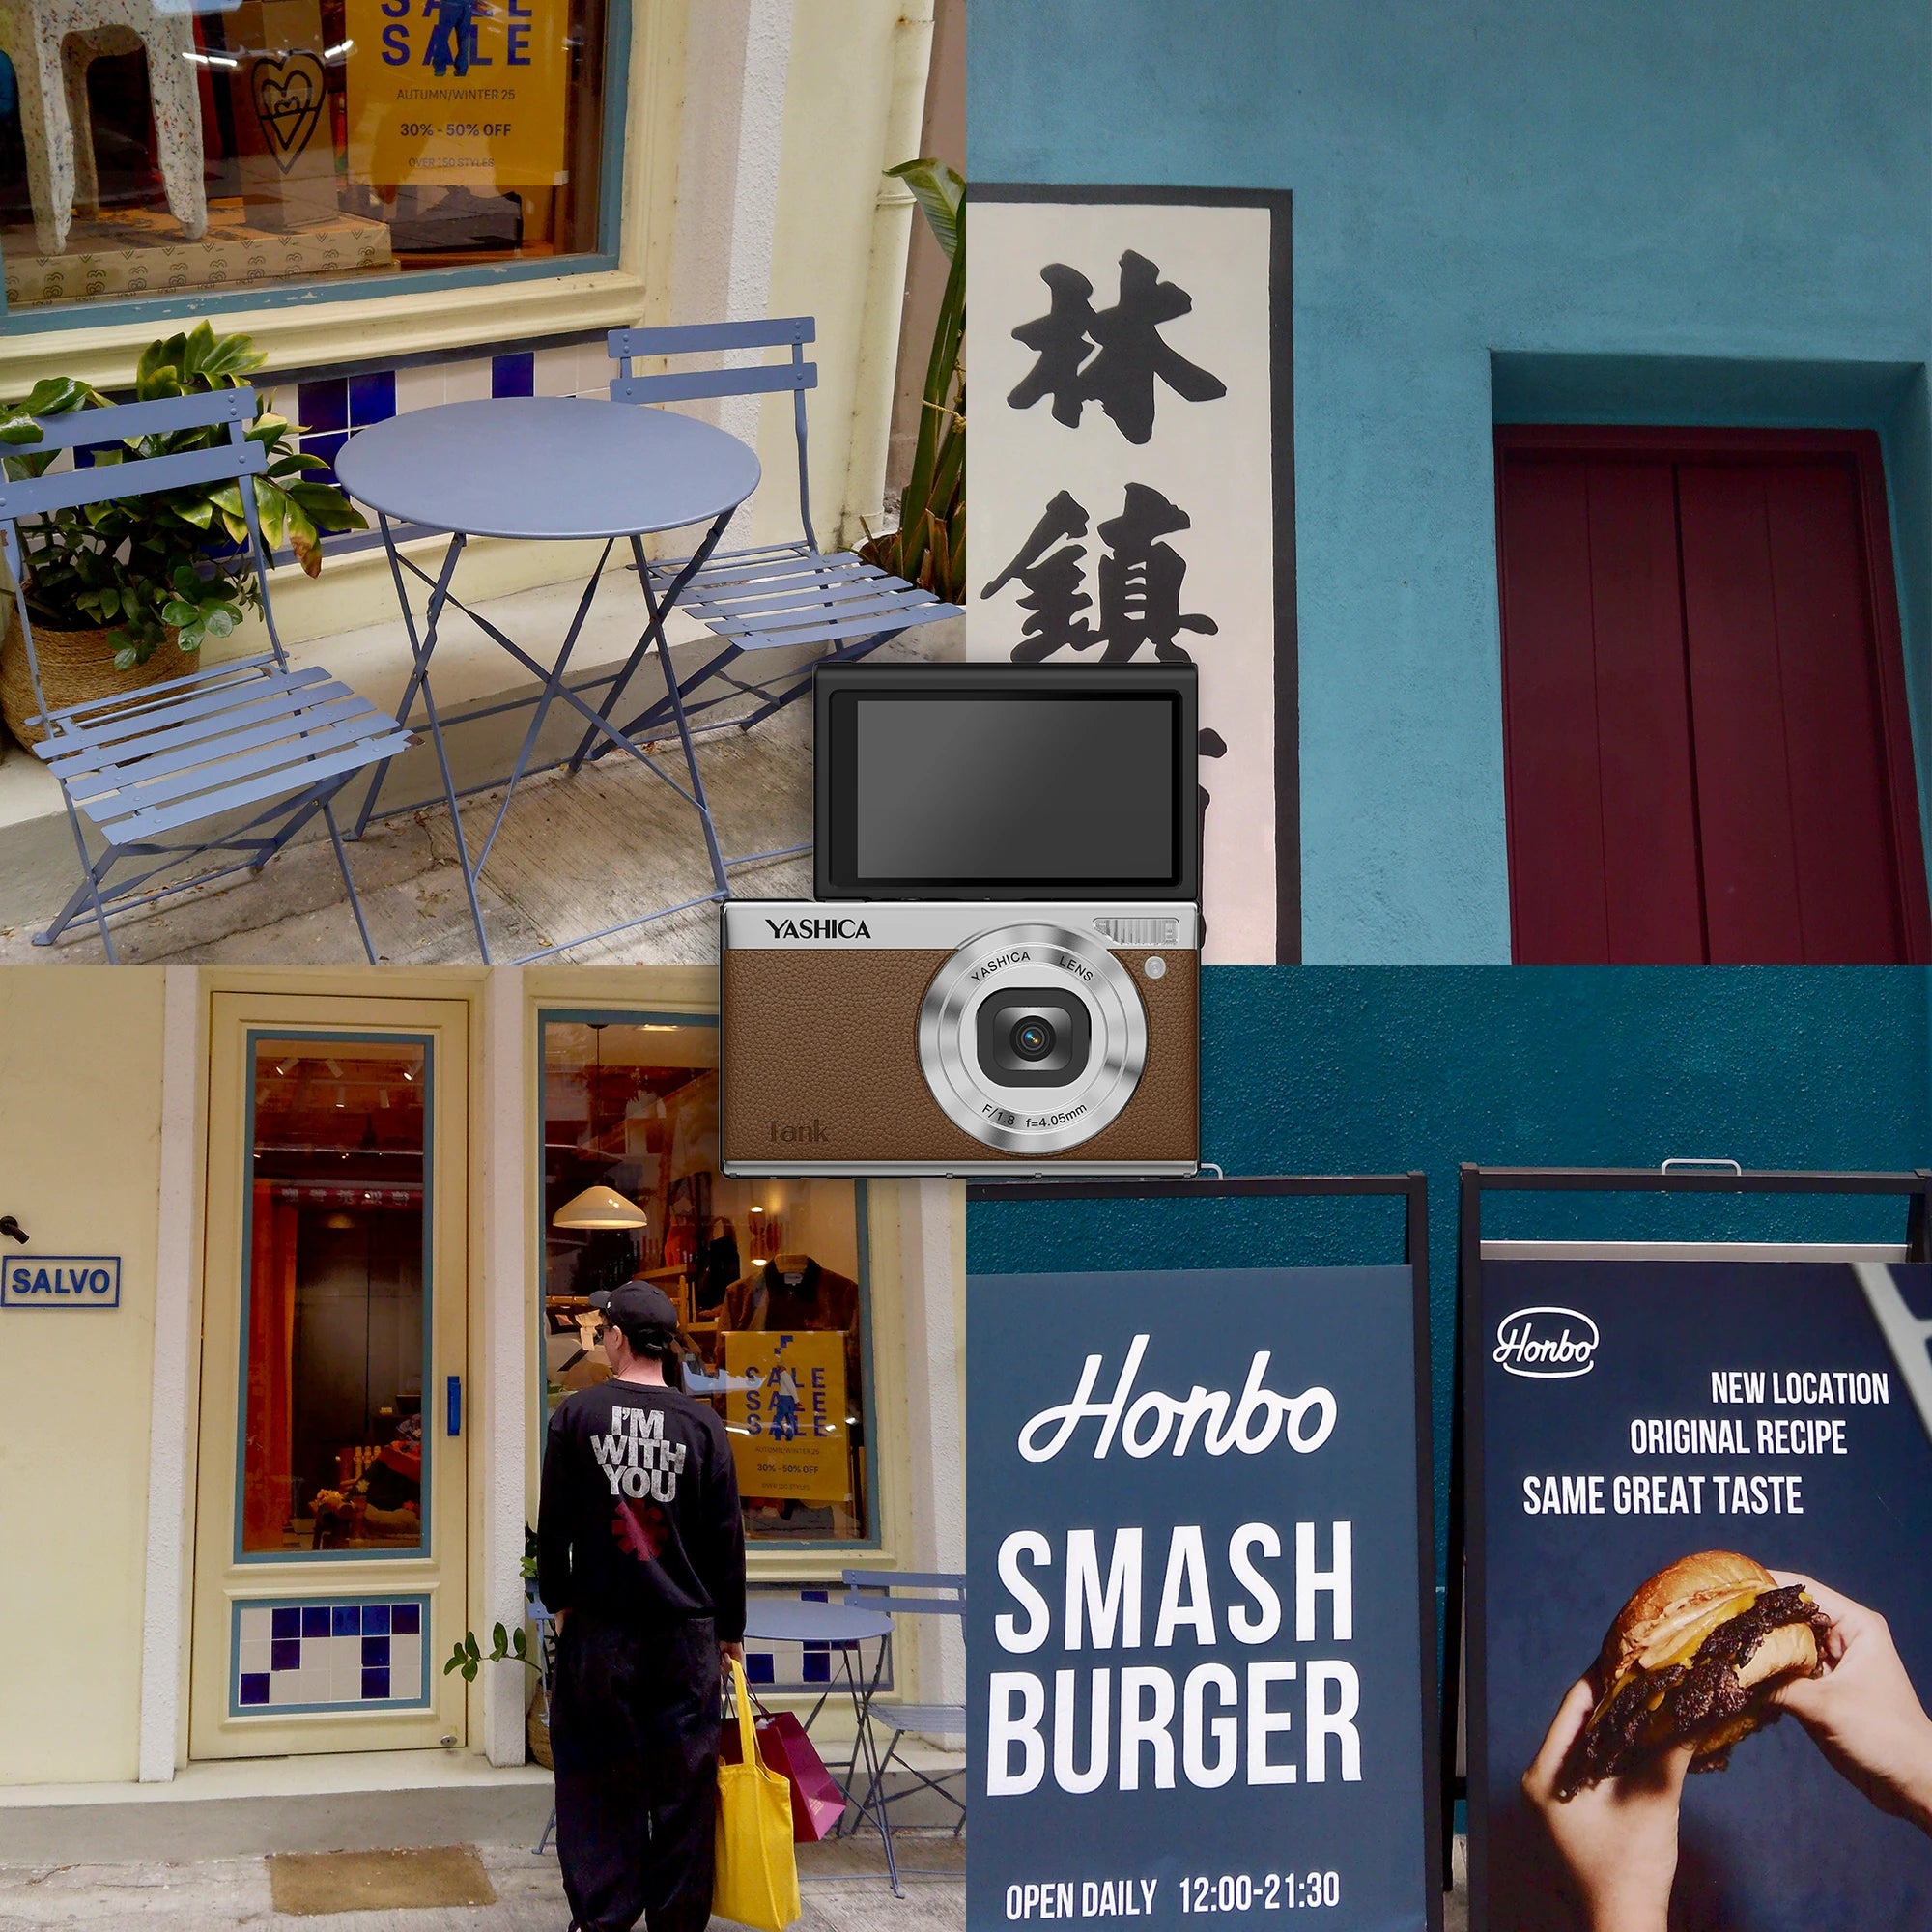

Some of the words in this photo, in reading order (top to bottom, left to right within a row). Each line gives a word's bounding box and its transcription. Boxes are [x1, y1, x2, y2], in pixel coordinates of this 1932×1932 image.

[397, 89, 498, 102] AUTUMN/WINTER
[501, 89, 515, 100] 25
[400, 124, 434, 136] 30%
[446, 124, 479, 136] 50%
[483, 124, 511, 136] OFF
[408, 157, 435, 167] OVER
[457, 157, 495, 167] STYLES
[765, 919, 871, 939] YASHICA
[971, 952, 1031, 982] YASHICA
[1059, 956, 1094, 981] LENS
[764, 1119, 829, 1142] Tank
[981, 1104, 1015, 1125] F/1.8
[1025, 1104, 1088, 1127] f=4.05mm
[12, 1268, 110, 1294] SALVO
[1492, 1322, 1595, 1363] Honbo
[1017, 1334, 1338, 1463] Honbo
[1711, 1371, 1766, 1404] NEW
[1772, 1371, 1889, 1405] LOCATION
[1630, 1419, 1750, 1454] ORIGINAL
[1756, 1419, 1847, 1454] RECIPE
[589, 1434, 687, 1474] WITH
[757, 1463, 776, 1472] 30%
[601, 1464, 676, 1503] YOU
[1522, 1475, 1605, 1515] SAME
[1612, 1475, 1705, 1515] GREAT
[1712, 1475, 1804, 1515] TASTE
[995, 1520, 1352, 1654] SMASH
[986, 1659, 1362, 1797] BURGER
[1006, 1883, 1074, 1920] OPEN
[1081, 1879, 1157, 1918] DAILY
[1179, 1871, 1341, 1913] 12:00-21:30
